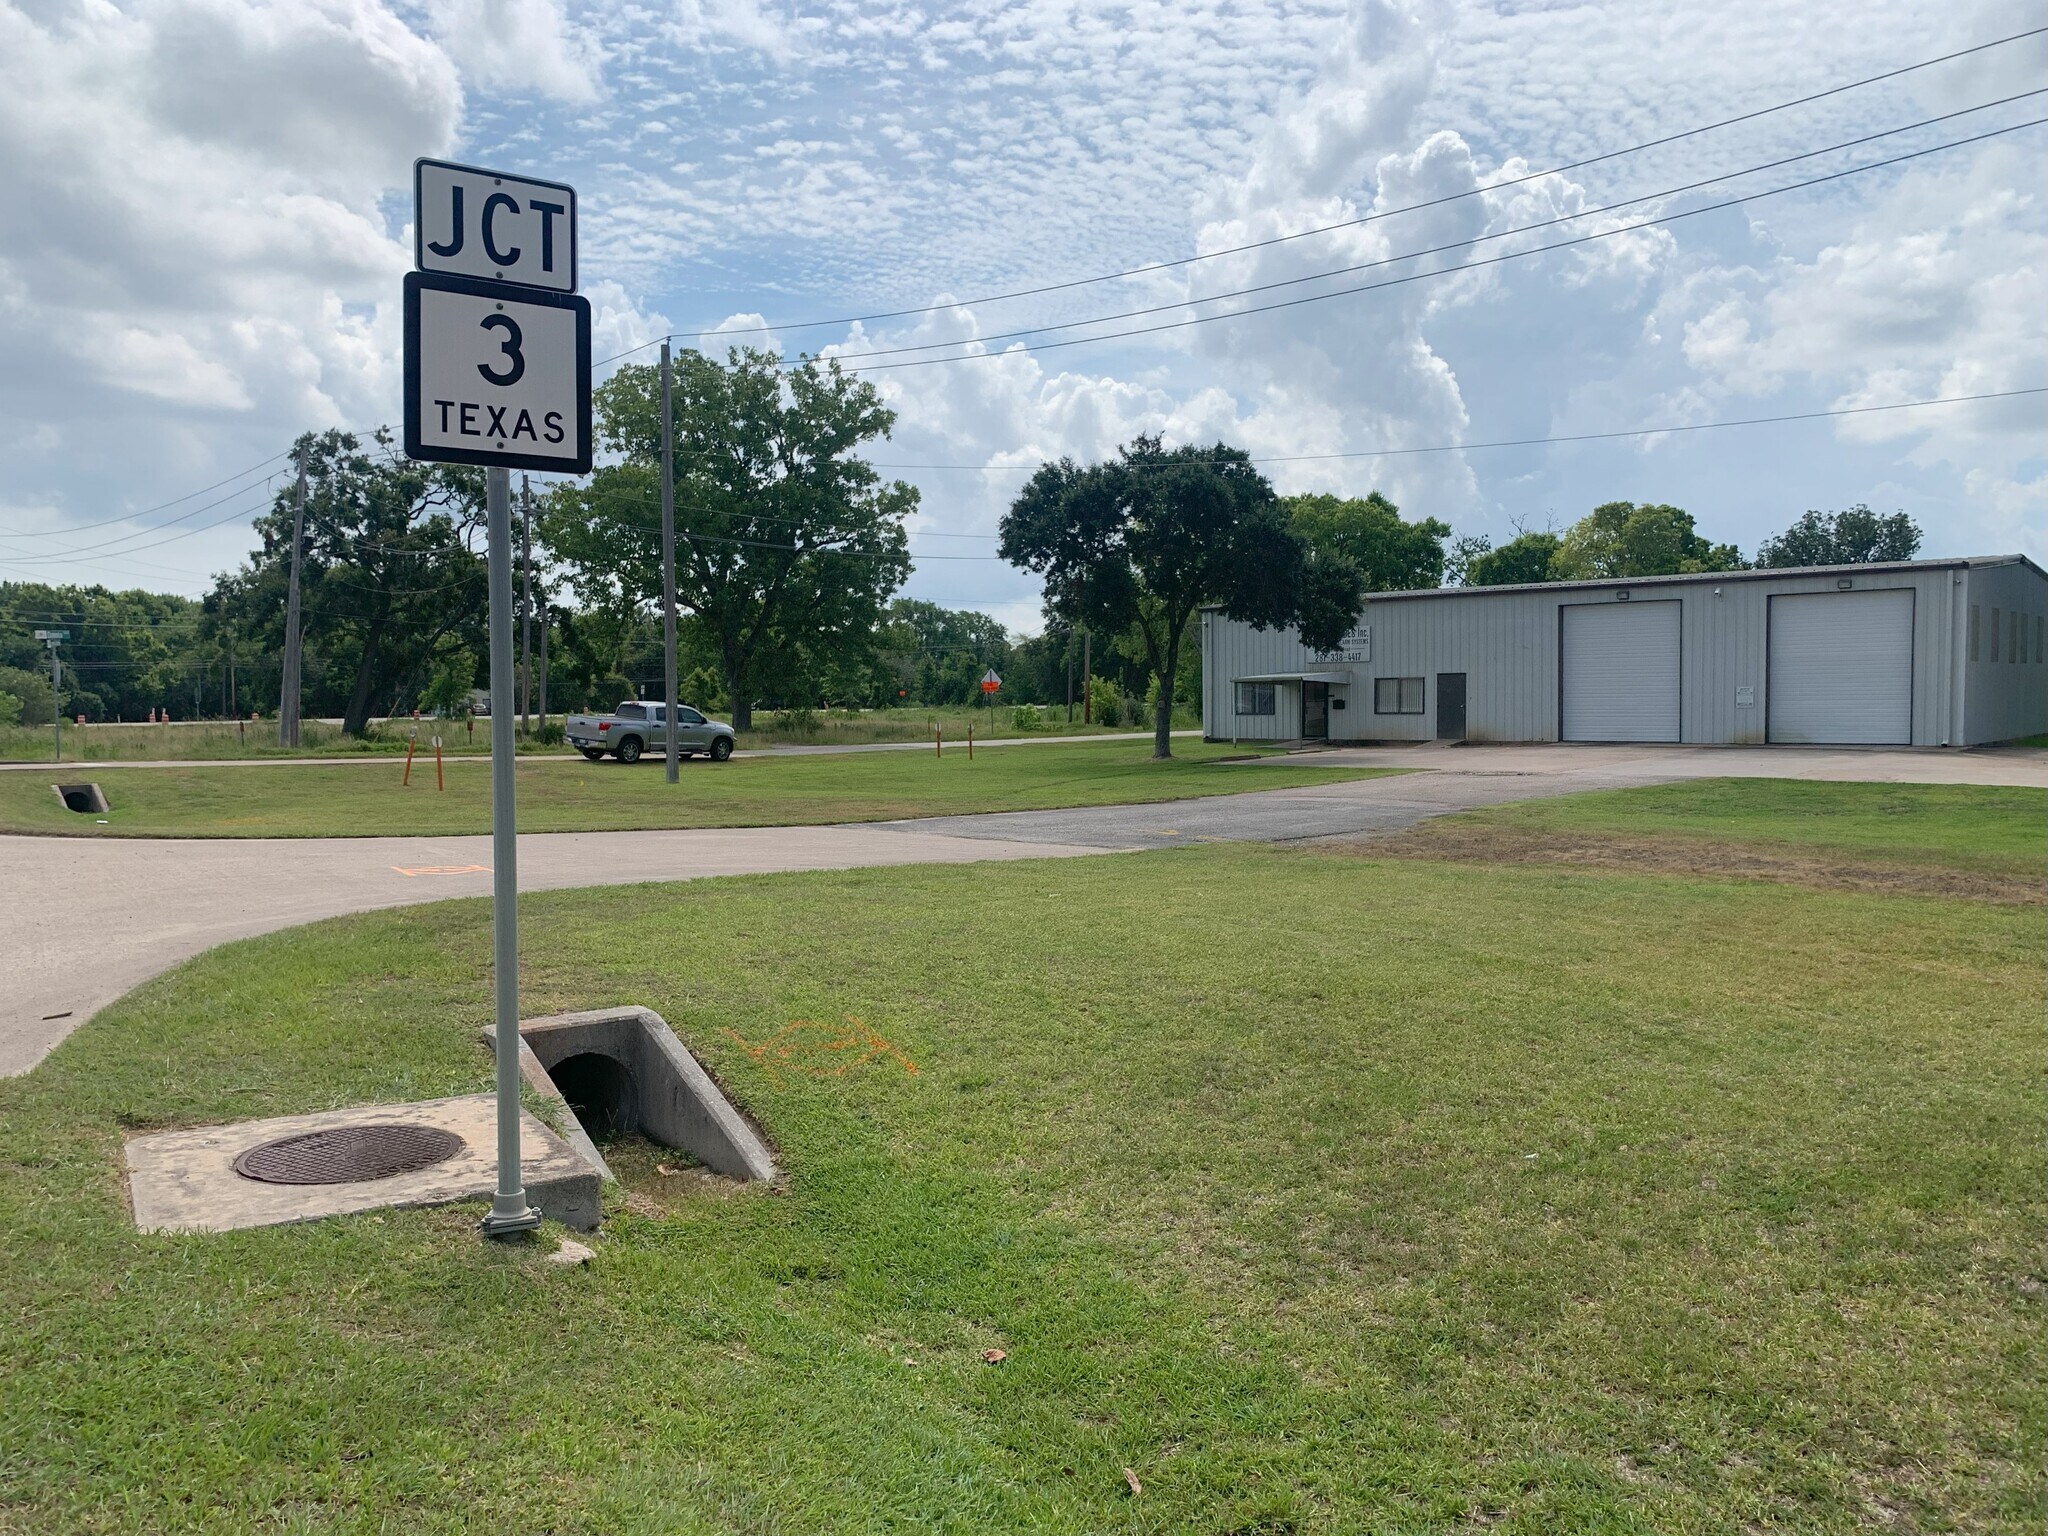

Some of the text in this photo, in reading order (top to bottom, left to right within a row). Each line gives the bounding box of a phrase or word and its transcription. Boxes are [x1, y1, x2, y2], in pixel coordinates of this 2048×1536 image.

[427, 186, 565, 273] JCT
[477, 313, 525, 387] 3
[434, 399, 565, 444] TEXAS
[1357, 627, 1369, 638] Inc.
